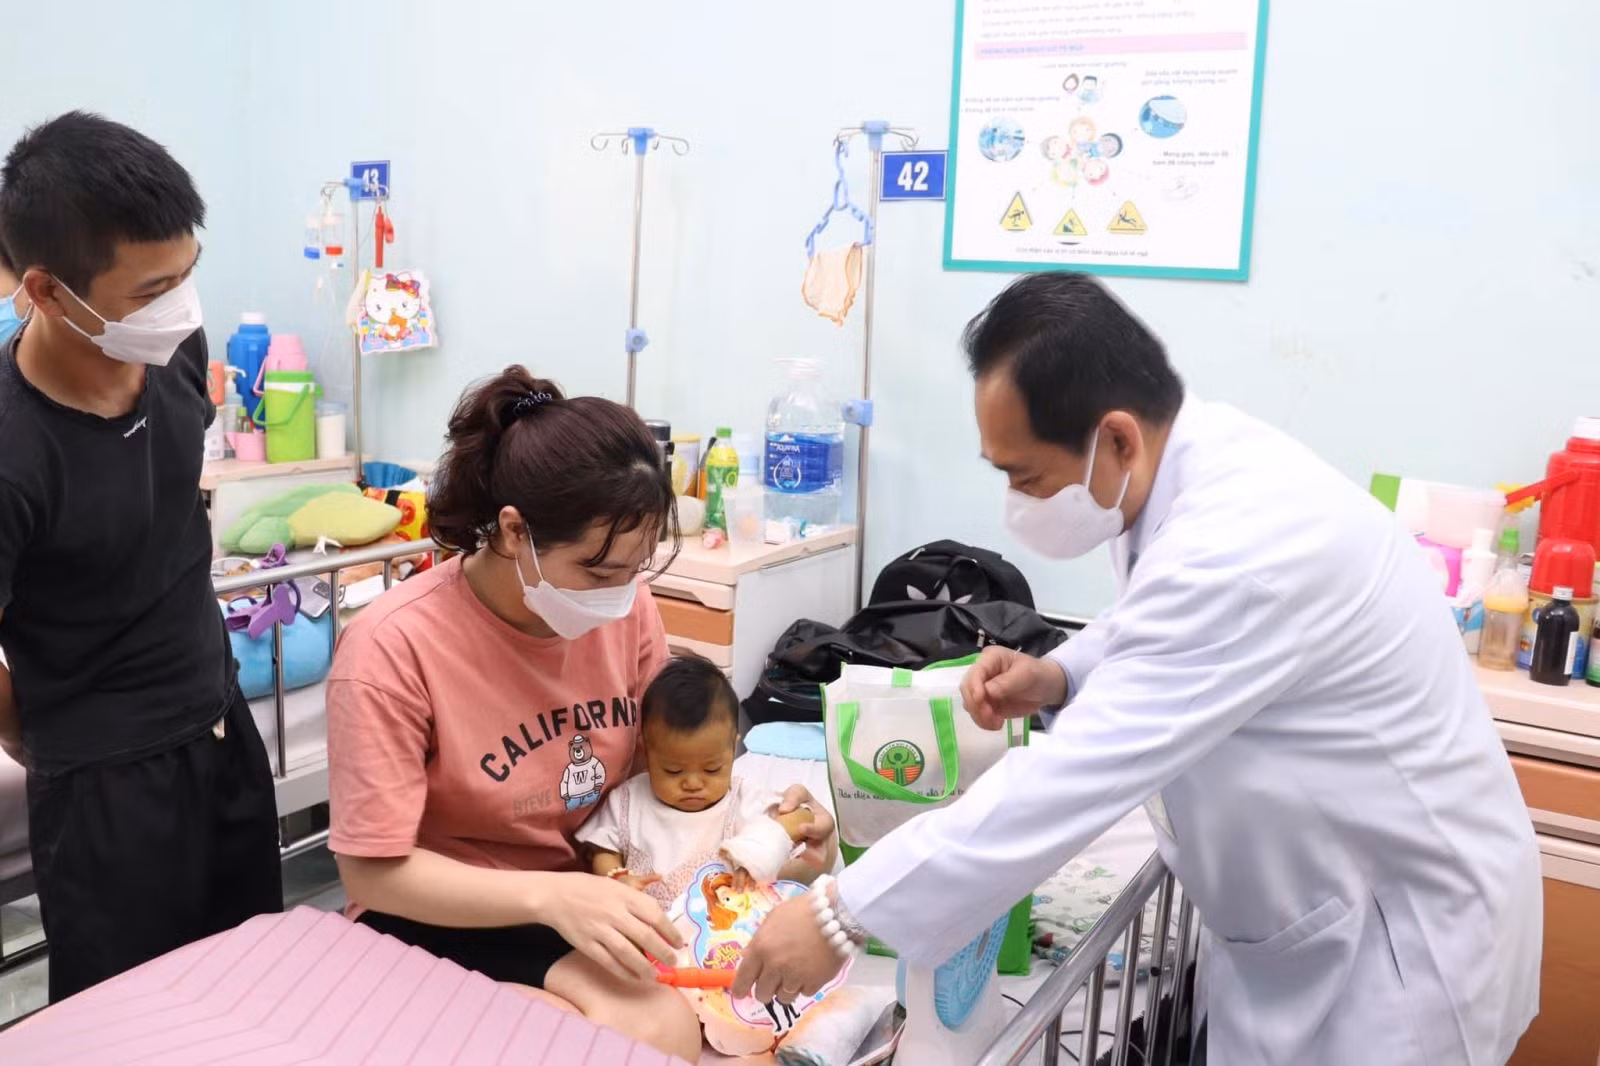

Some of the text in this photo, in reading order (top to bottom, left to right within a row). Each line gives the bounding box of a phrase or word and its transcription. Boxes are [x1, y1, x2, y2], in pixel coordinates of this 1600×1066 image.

[362, 167, 379, 193] 43
[897, 160, 929, 191] 42
[573, 770, 588, 785] W
